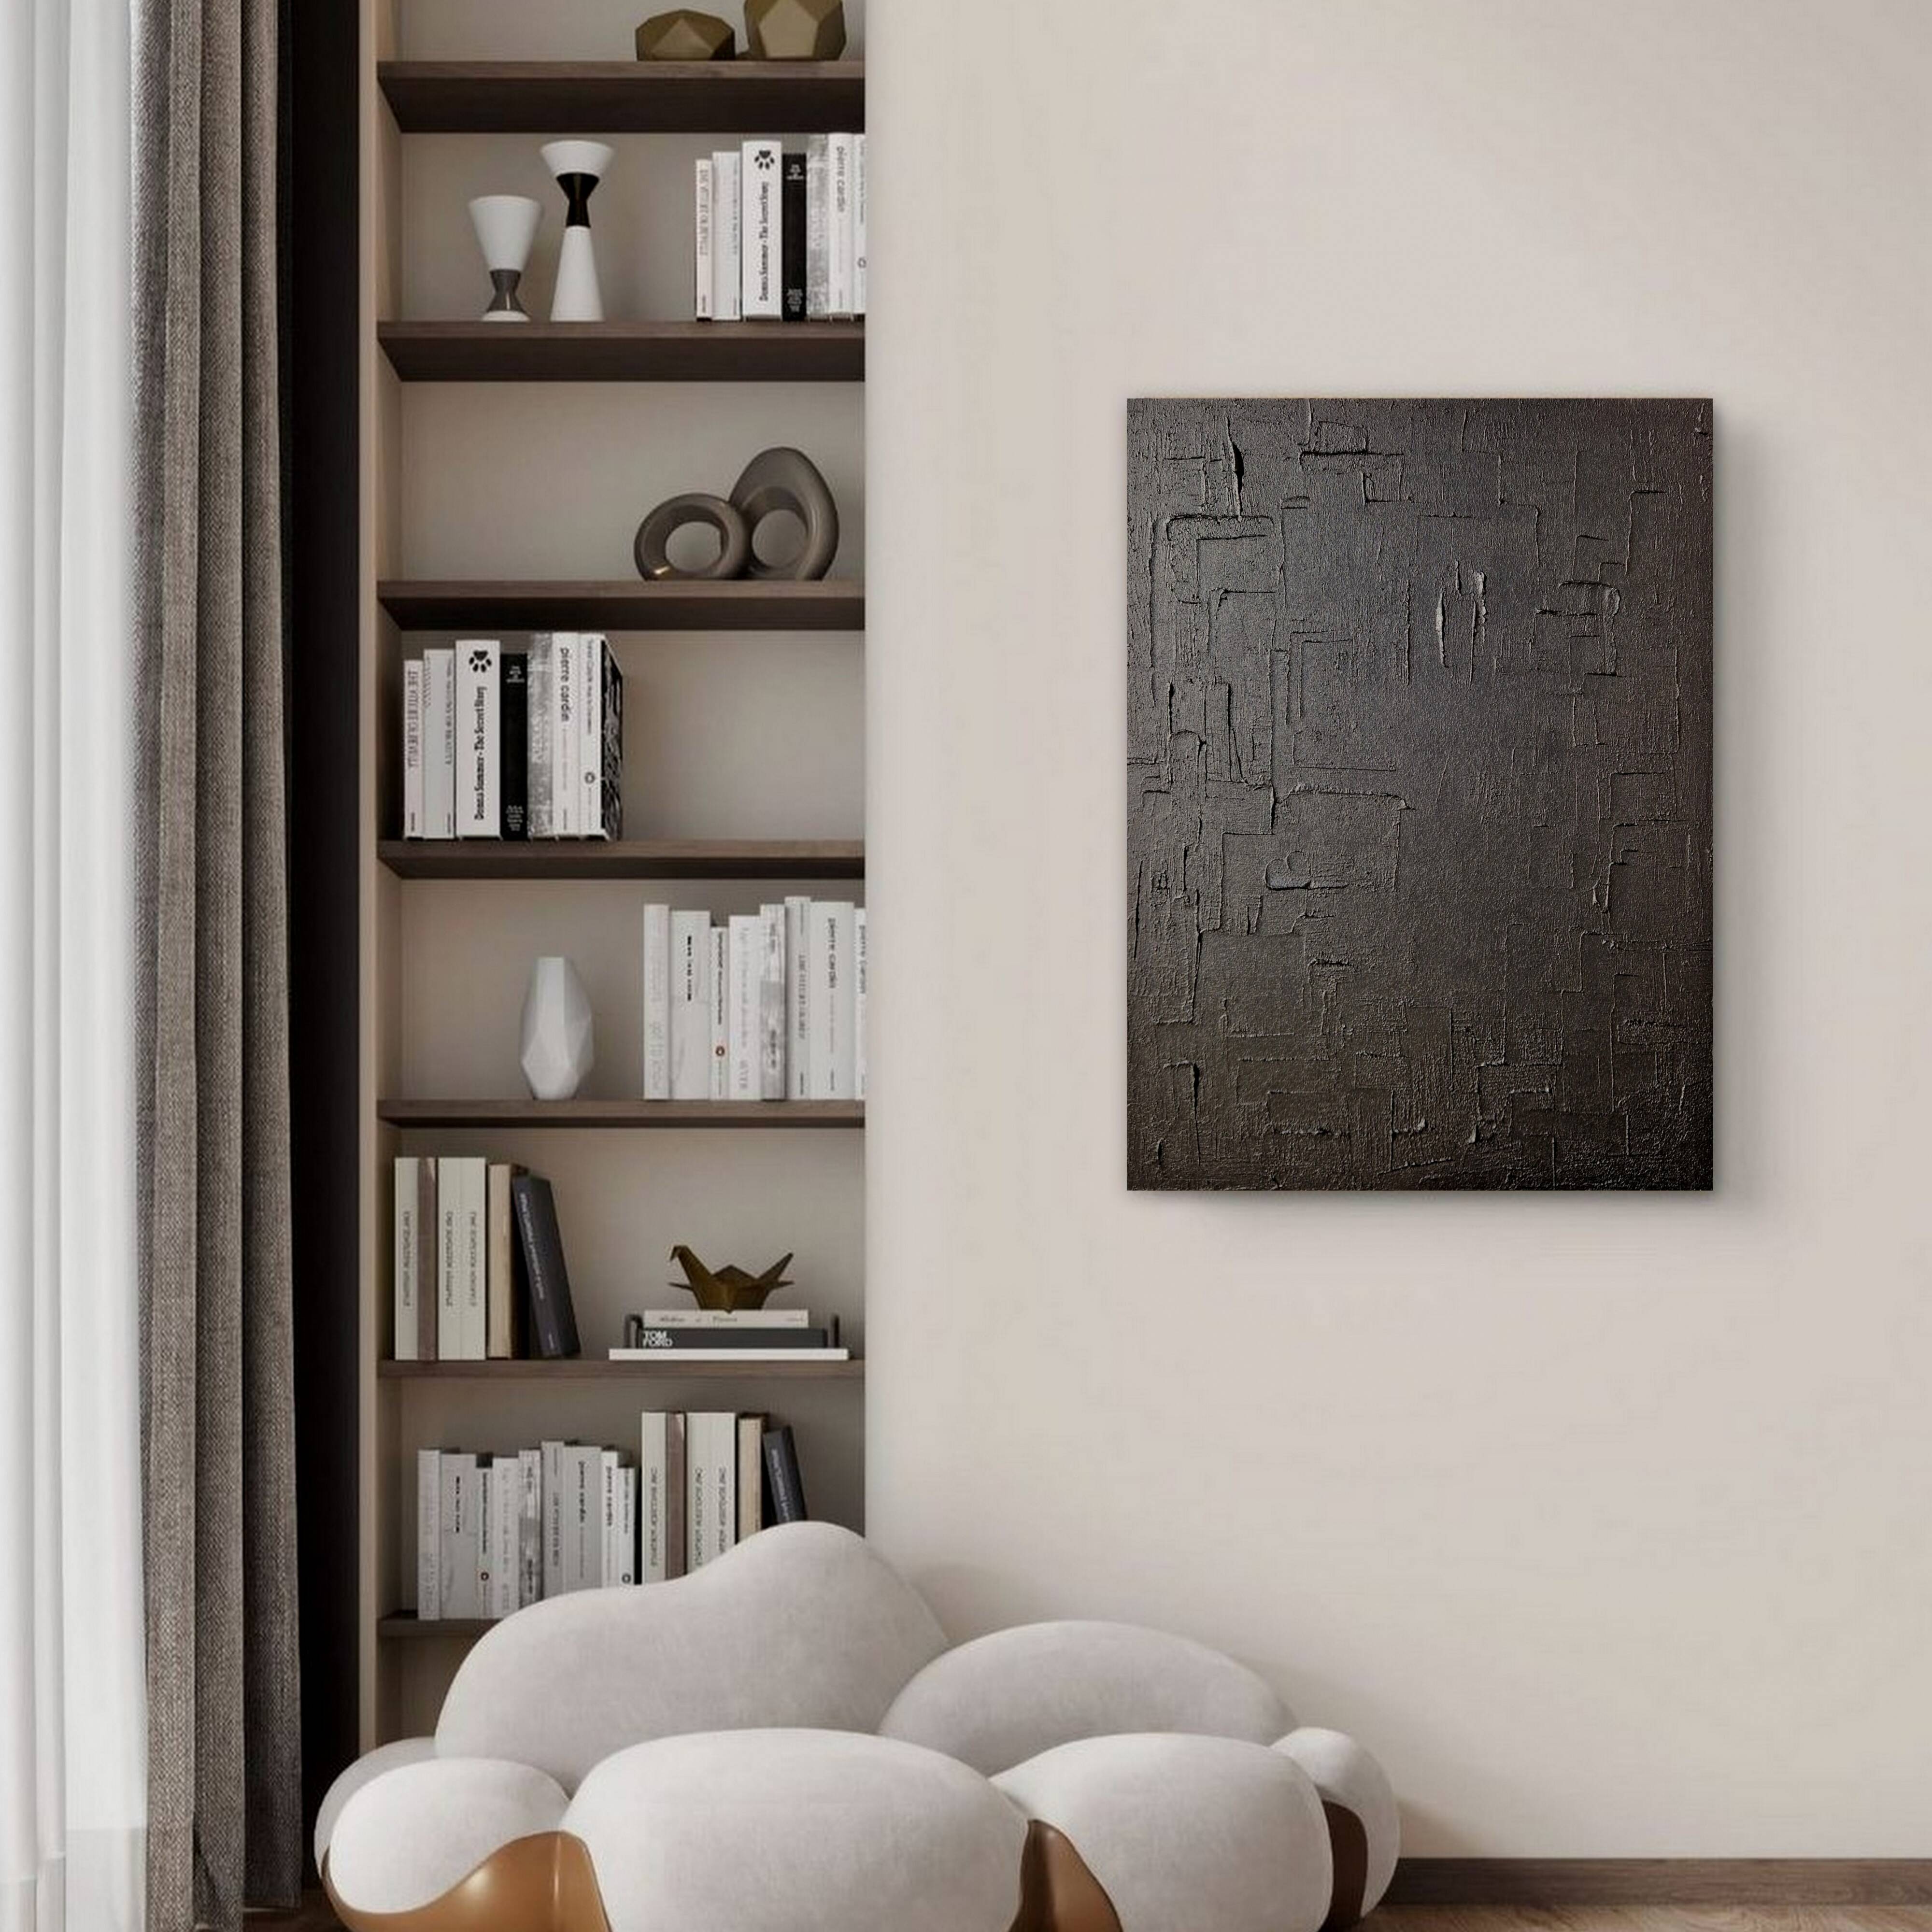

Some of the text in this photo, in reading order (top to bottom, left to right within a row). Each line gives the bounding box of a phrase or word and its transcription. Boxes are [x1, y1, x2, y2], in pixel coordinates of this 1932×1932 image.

[560, 648, 570, 682] pierre
[561, 685, 571, 722] cardin
[474, 735, 484, 751] The
[474, 757, 484, 791] Summer
[474, 793, 484, 820] Donna
[643, 1338, 673, 1347] FORD
